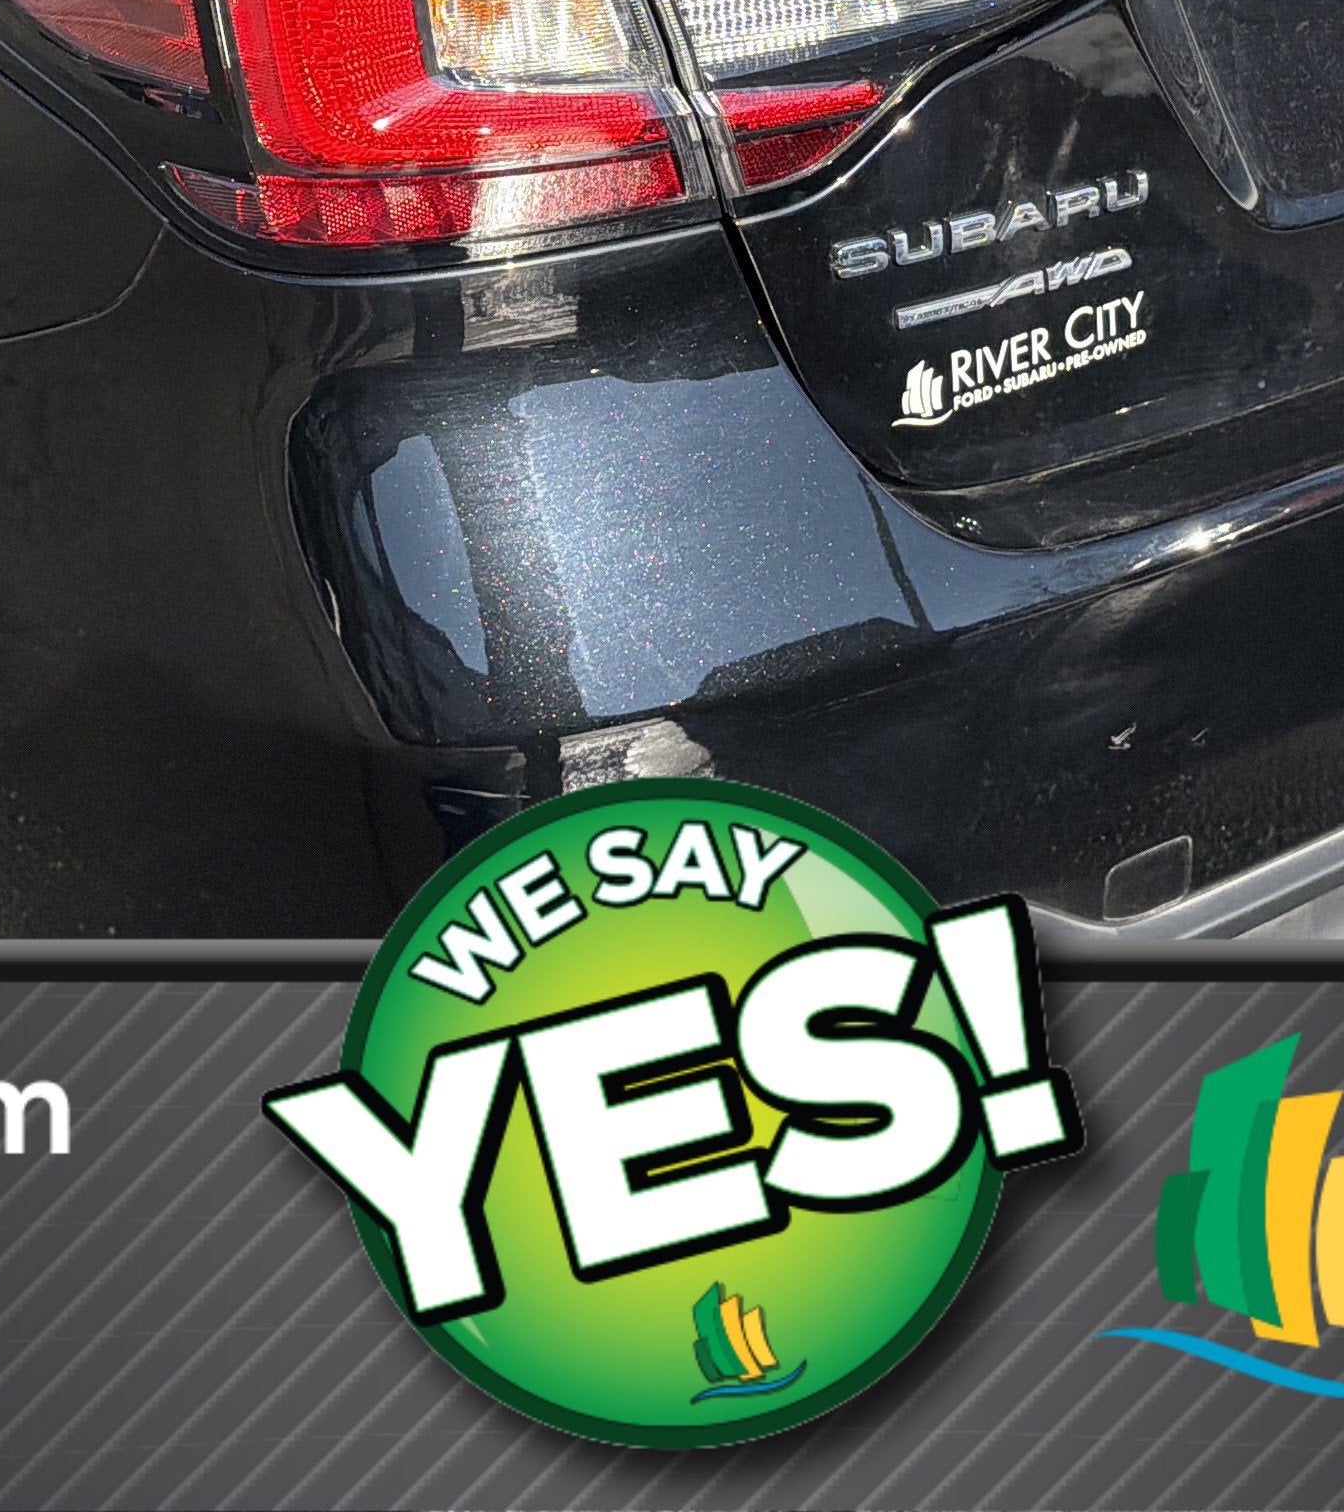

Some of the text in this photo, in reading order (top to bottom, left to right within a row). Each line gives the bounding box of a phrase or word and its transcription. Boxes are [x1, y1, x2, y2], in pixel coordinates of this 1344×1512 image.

[830, 169, 1149, 280] SUBARU
[987, 247, 1133, 308] AWD
[950, 290, 1144, 392] RIVER CITY
[953, 329, 1147, 411] FORD SUBARU PRE-OWNED
